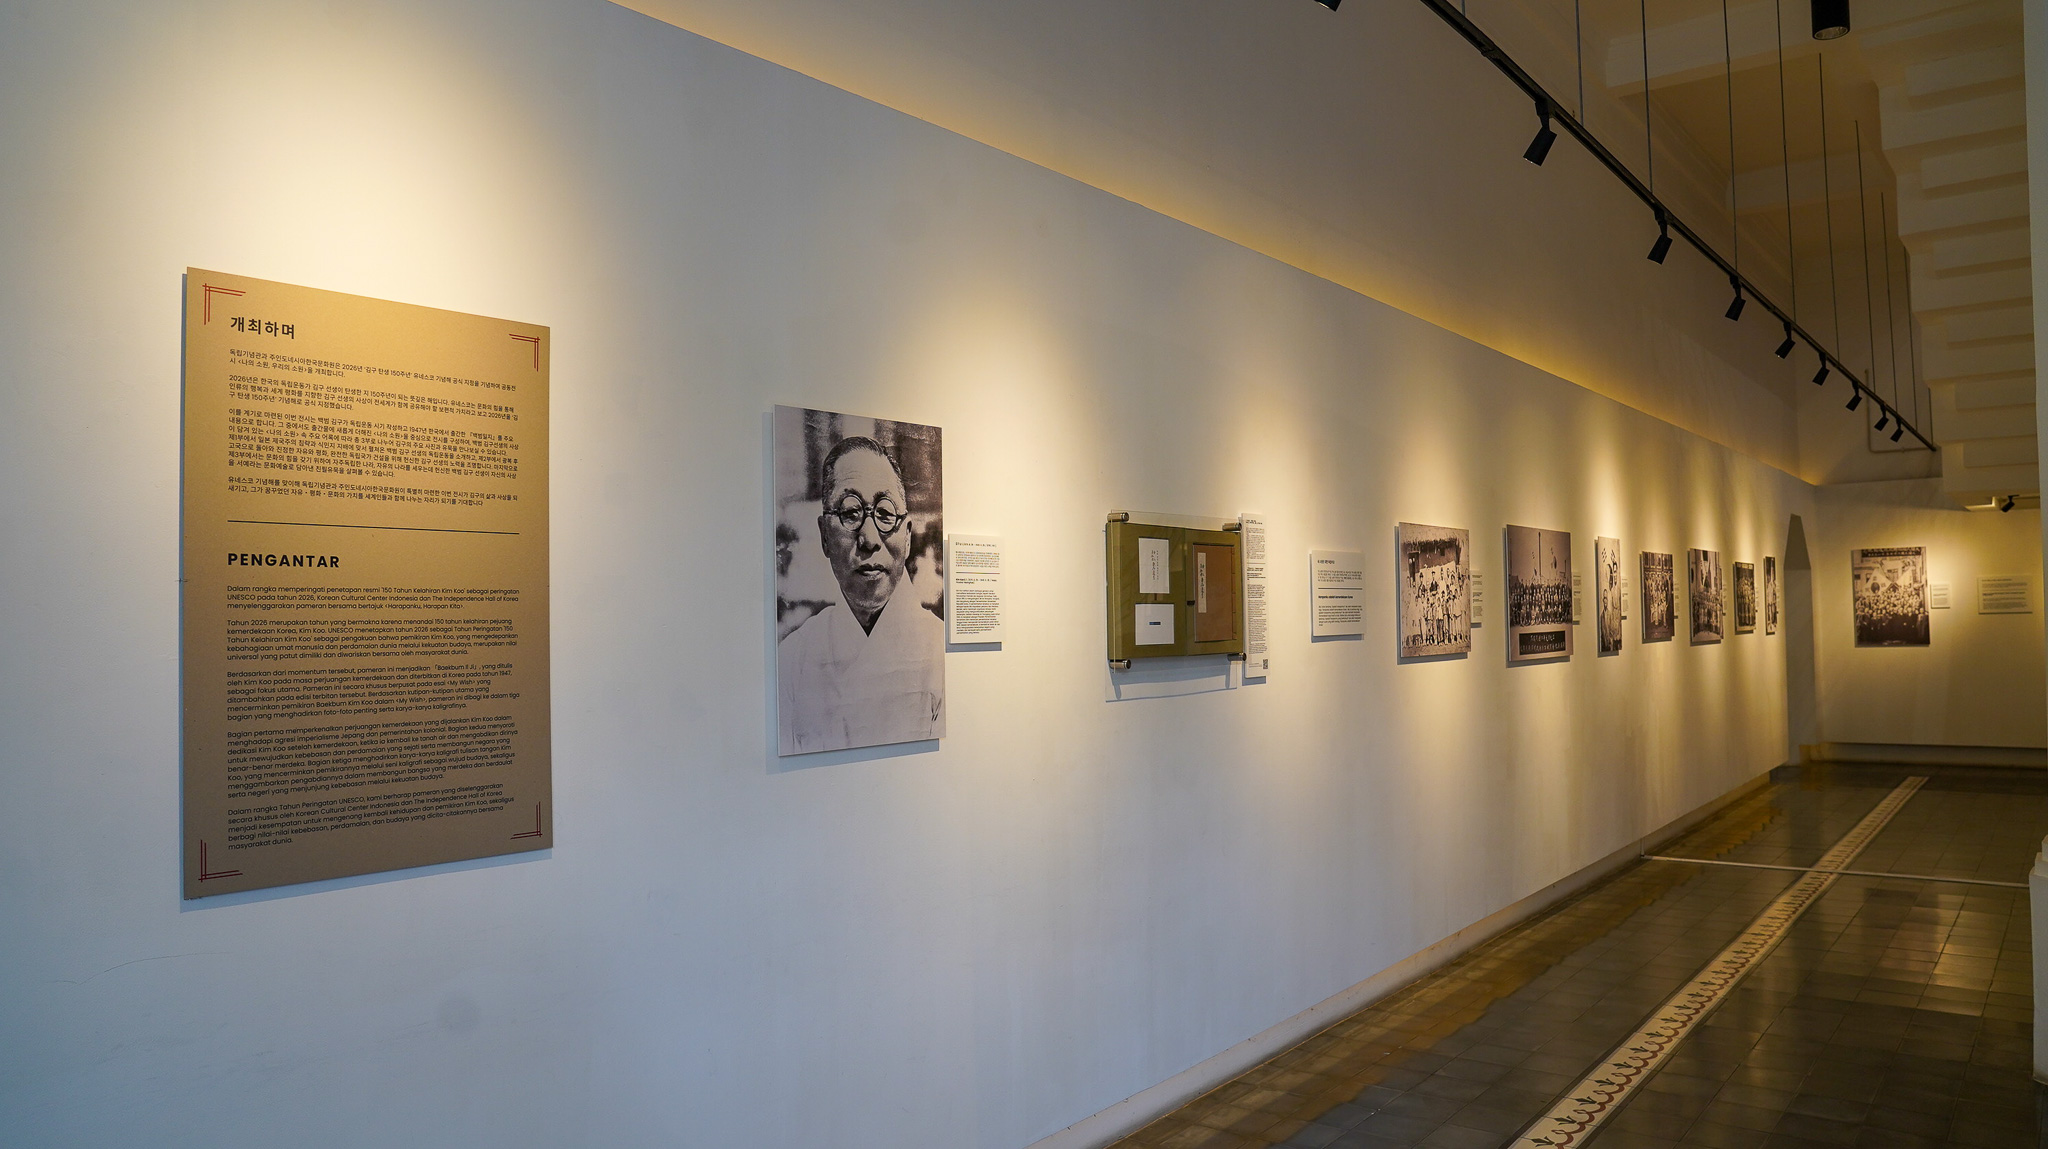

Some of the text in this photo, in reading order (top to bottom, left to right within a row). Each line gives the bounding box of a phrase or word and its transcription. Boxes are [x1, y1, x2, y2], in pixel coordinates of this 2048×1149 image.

[230, 316, 294, 339] 개최하며
[227, 553, 339, 567] PENGANTAR
[252, 585, 276, 593] rangka
[277, 586, 325, 594] memperingati
[227, 602, 294, 610] menyelenggarakan
[268, 619, 308, 627] merupakan
[227, 713, 252, 721] bagian
[273, 710, 322, 719] menghadirkan
[353, 707, 377, 715] penting
[395, 704, 431, 712] karya-karya
[253, 729, 284, 737] pertama
[285, 725, 343, 734] memperkenalkan
[344, 723, 380, 732] perjuangan
[381, 720, 423, 728] kemerdekaan
[440, 717, 470, 725] dijalankan
[247, 788, 269, 797] negeri
[290, 784, 329, 792] menjunjung
[330, 780, 366, 788] kebebasan
[253, 805, 277, 813] rangka
[301, 799, 337, 808] Peringatan
[412, 789, 440, 798] pameran
[456, 783, 503, 792] diselenggarakan
[228, 839, 270, 849] masyarakat
